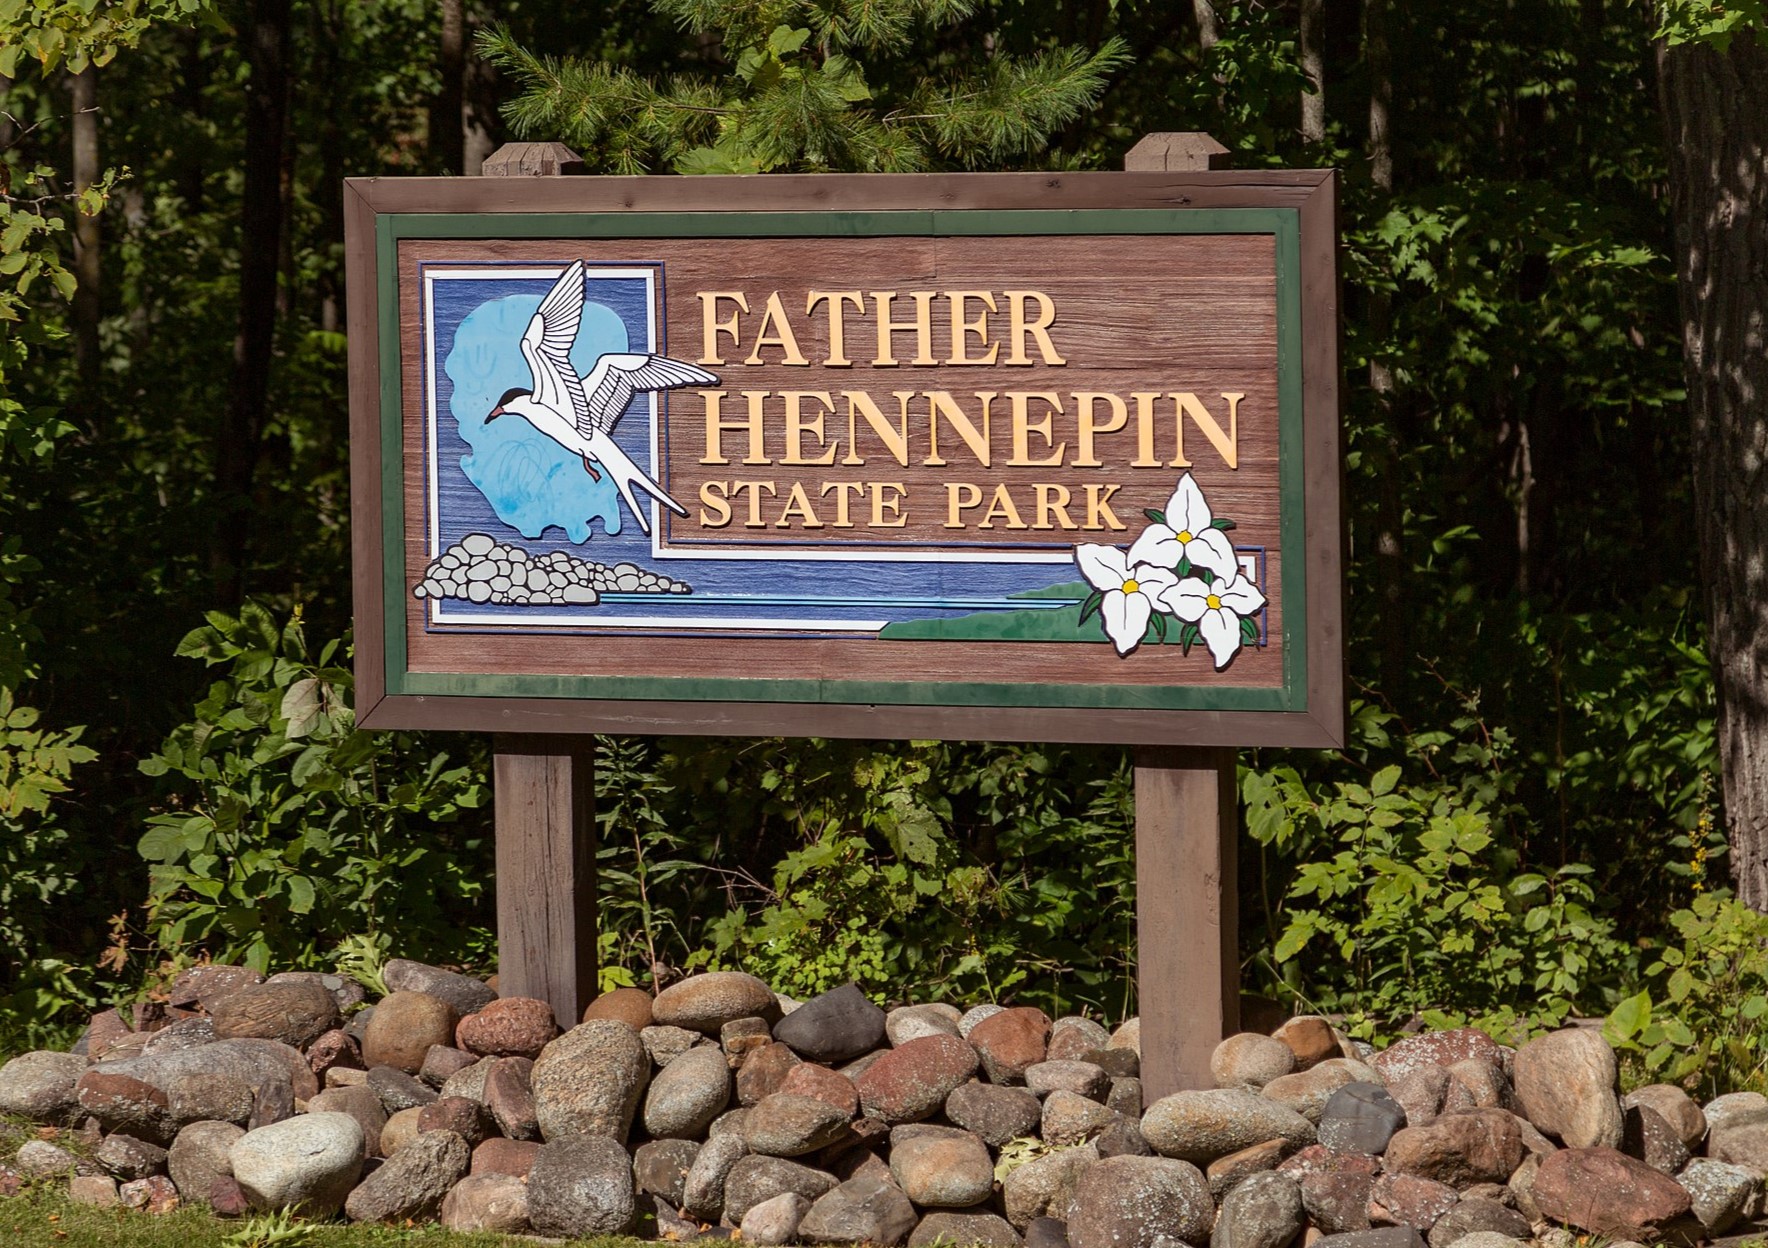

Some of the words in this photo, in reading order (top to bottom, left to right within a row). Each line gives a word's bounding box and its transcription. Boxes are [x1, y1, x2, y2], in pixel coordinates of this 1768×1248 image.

[696, 290, 1066, 366] FATHER
[698, 390, 1245, 469] HENNEPIN
[699, 480, 908, 528] STATE
[943, 482, 1127, 531] PARK
